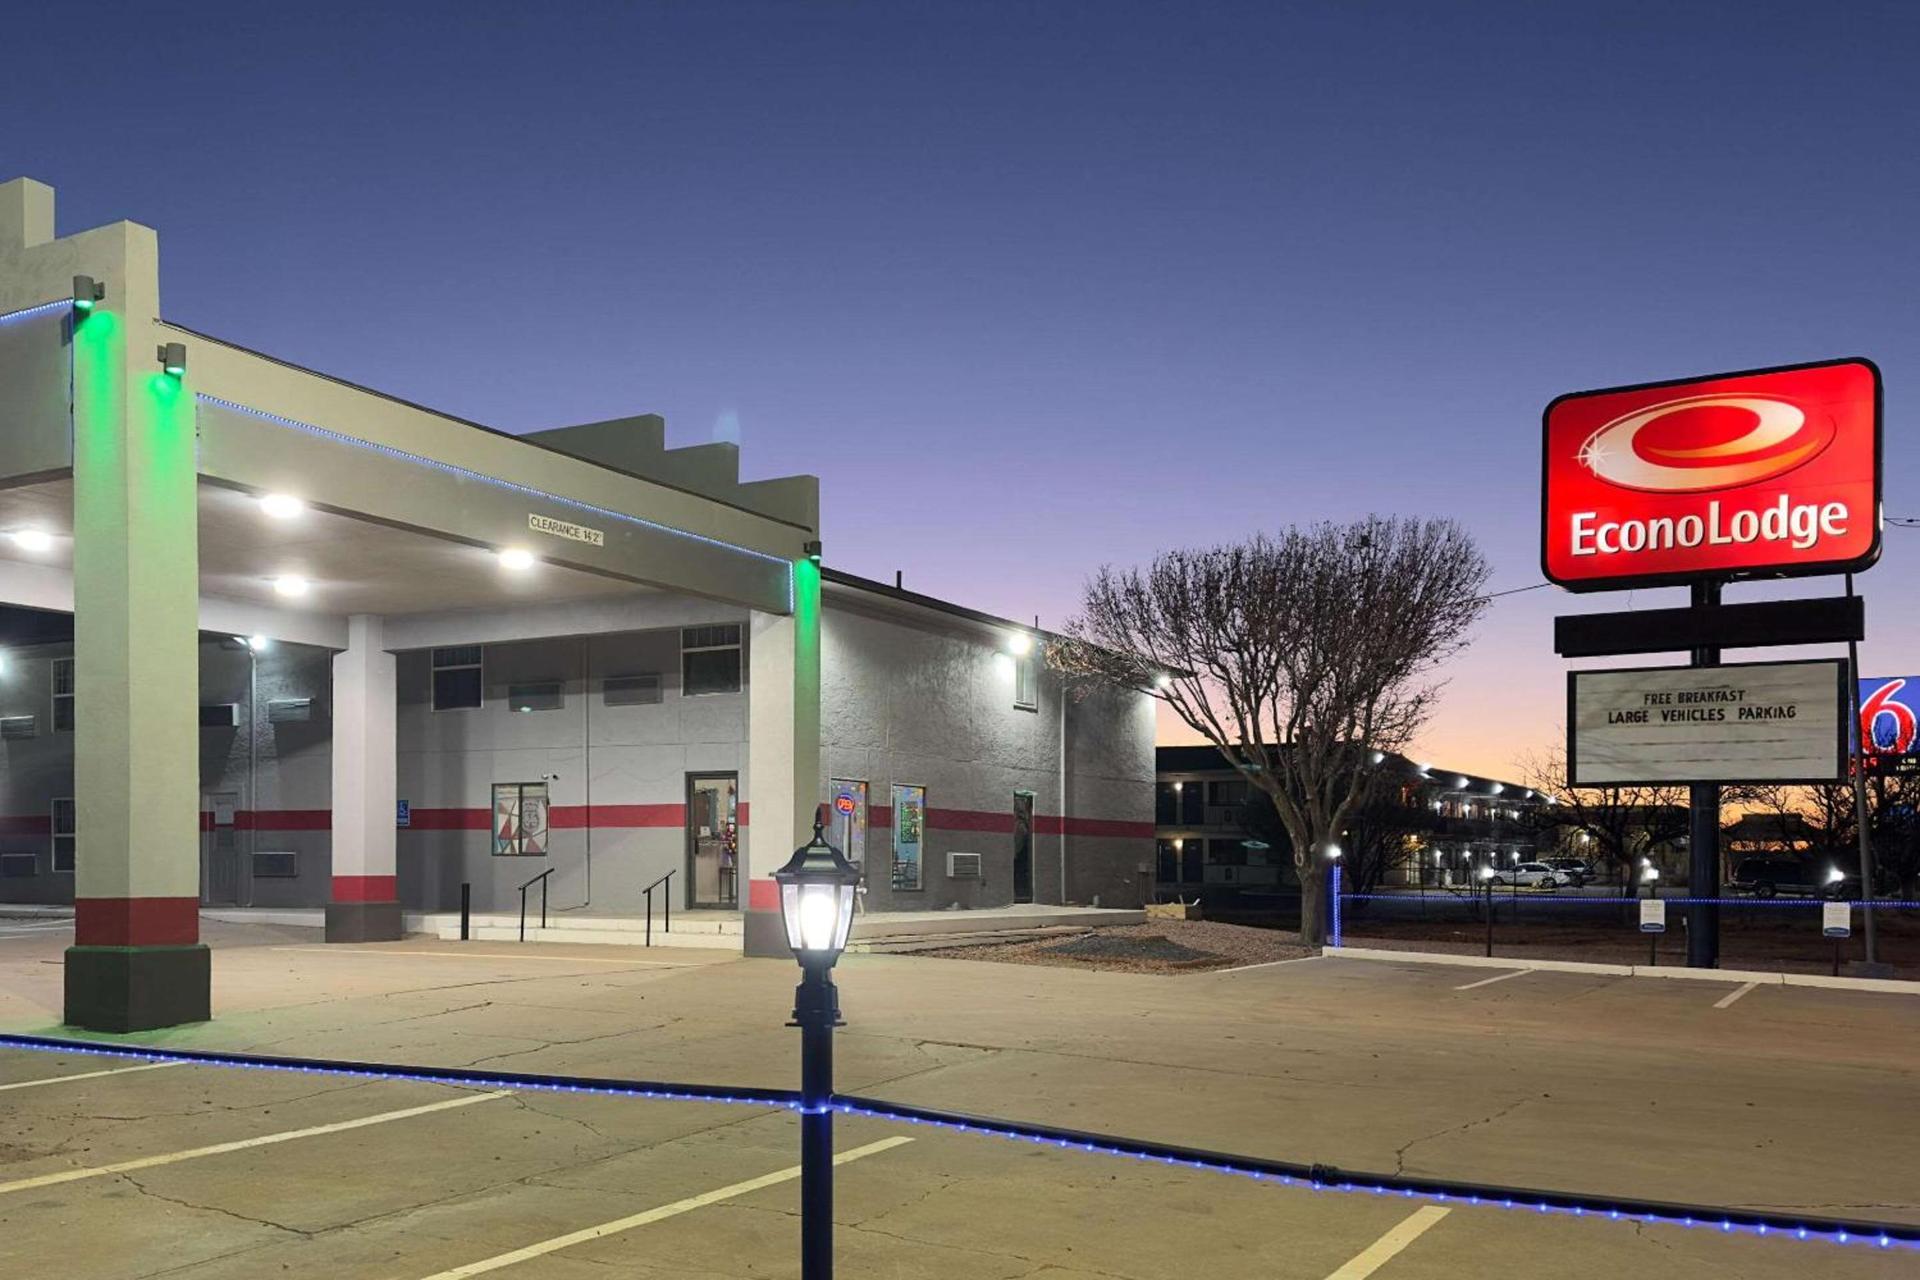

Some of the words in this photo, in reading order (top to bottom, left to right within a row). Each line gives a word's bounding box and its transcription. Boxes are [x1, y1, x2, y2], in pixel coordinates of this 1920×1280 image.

[530, 516, 581, 539] CLEARANCE
[1571, 494, 1849, 556] EconoLodge
[1644, 692, 1673, 706] FREE
[1677, 689, 1746, 704] BREAKFAST
[1608, 709, 1649, 725] LARGE
[1661, 708, 1726, 722] VEHICLES
[1738, 705, 1797, 720] PARKING
[1859, 678, 1917, 755] 6
